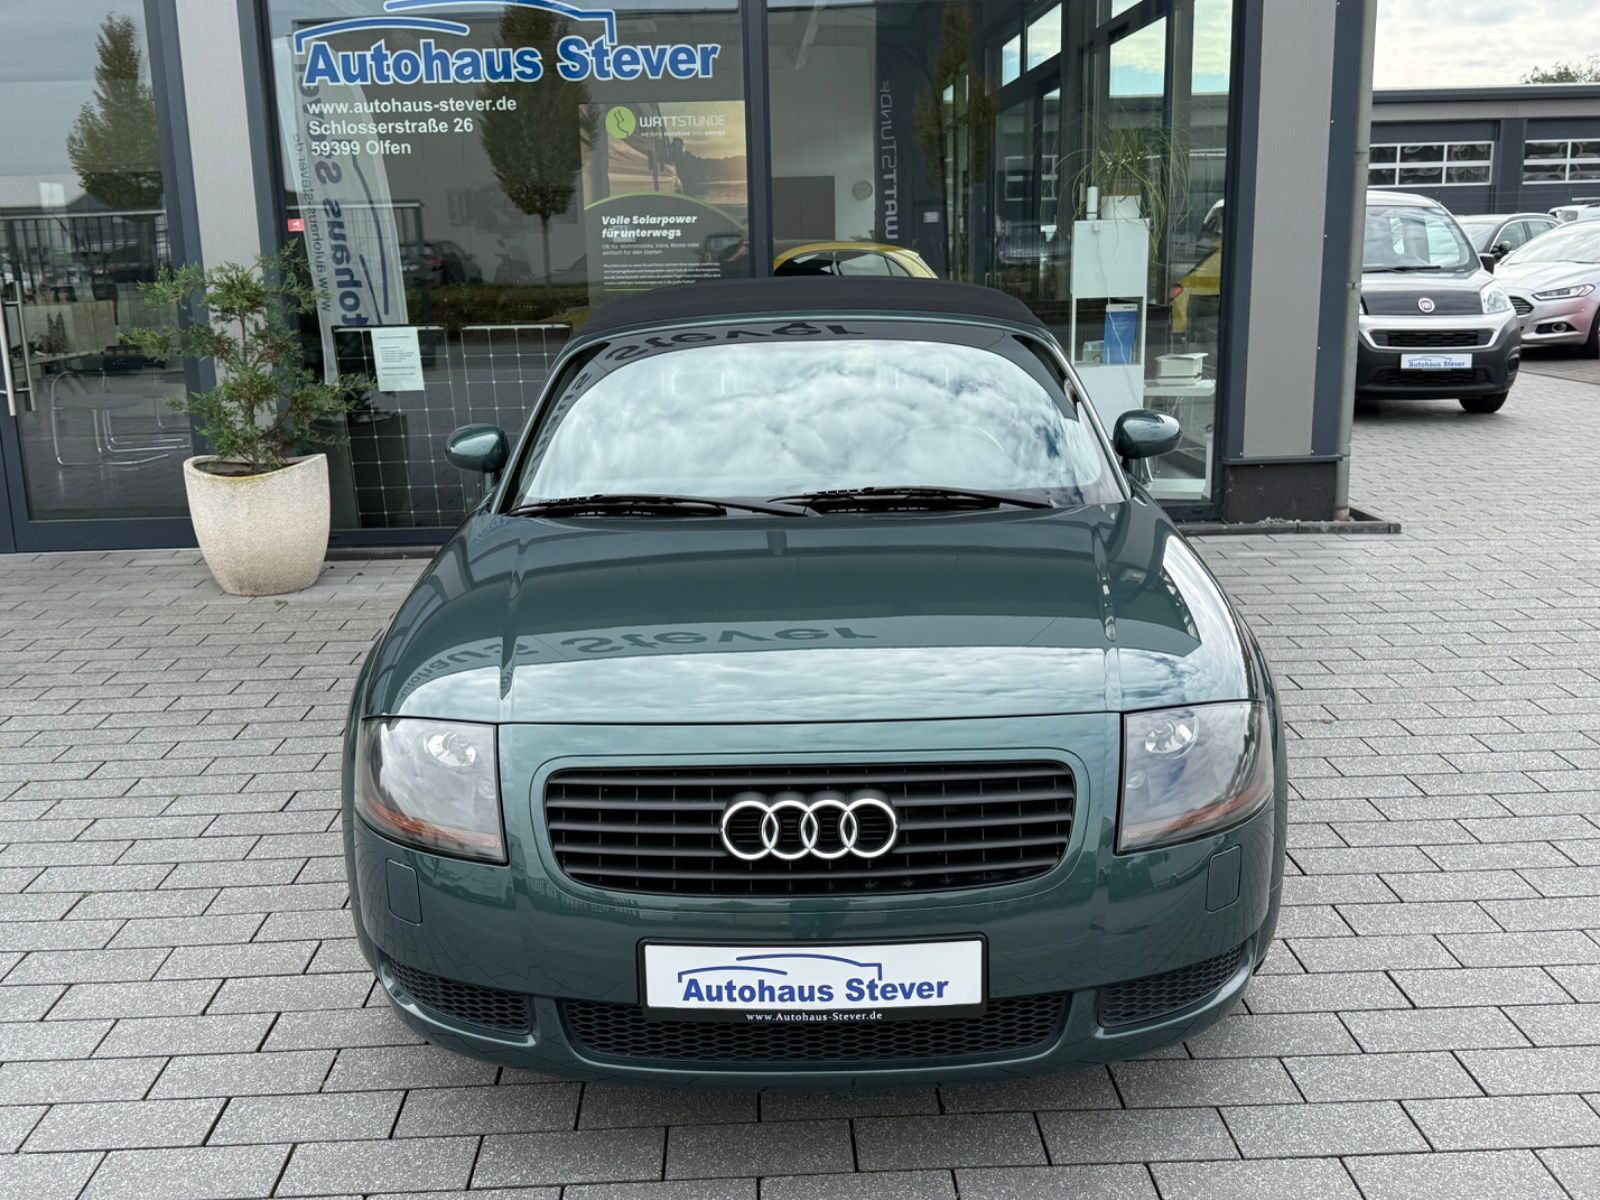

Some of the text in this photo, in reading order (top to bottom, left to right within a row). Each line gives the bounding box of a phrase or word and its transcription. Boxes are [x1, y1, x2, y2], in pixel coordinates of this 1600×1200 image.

[303, 35, 721, 86] Autohaus Stever
[307, 96, 517, 115] www.autohaus-stever.de
[308, 117, 474, 136] Schlosserstraße 26
[639, 114, 726, 128] WATTSTUNDE
[311, 138, 412, 157] 59399 Olfen
[602, 214, 698, 227] Volle Solarpower
[682, 977, 949, 1003] Autohaus Stever
[746, 1011, 883, 1022] www.Autohaus-Stever.de
